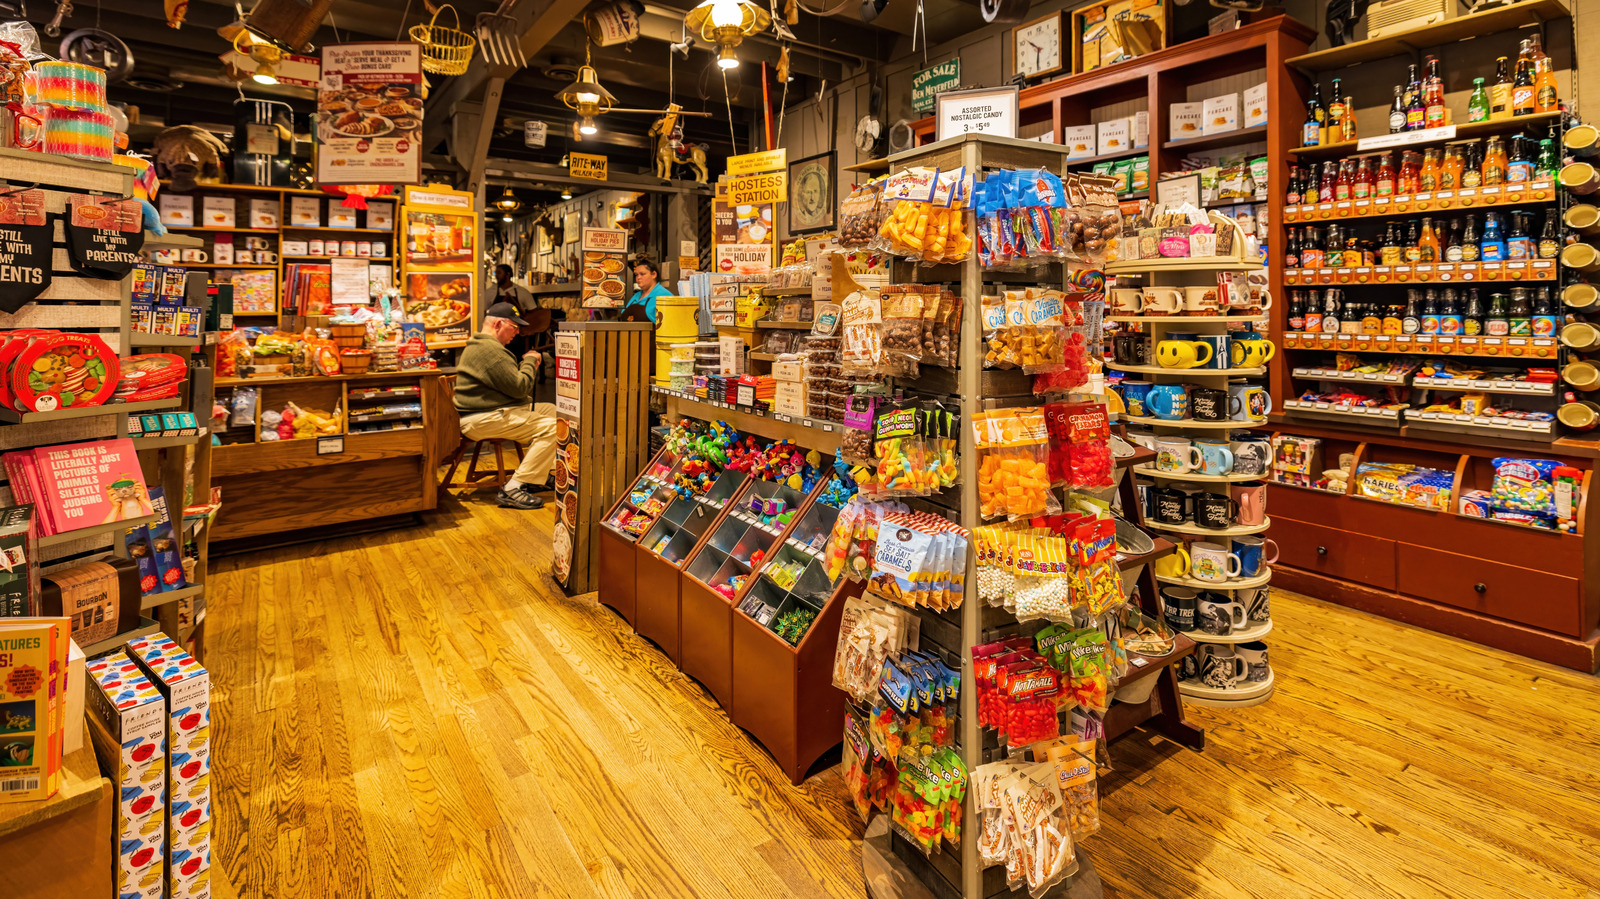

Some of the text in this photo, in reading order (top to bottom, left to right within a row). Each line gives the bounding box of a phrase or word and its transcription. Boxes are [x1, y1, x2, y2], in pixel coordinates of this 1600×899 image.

[913, 63, 957, 88] FOR SALE
[962, 105, 992, 113] ASSORTED
[951, 113, 983, 122] NOSTALGIC
[963, 124, 969, 132] 3
[571, 157, 606, 171] RITE-WAY
[572, 169, 593, 178] MILKER
[730, 175, 783, 192] HOSTESS
[735, 189, 779, 205] STATION
[722, 218, 733, 226] YOU
[93, 234, 128, 246] LIVE WITH
[105, 243, 116, 251] MY
[590, 237, 609, 245] HOLIDAY
[6, 242, 33, 255] WITH
[86, 249, 136, 264] PARENTS
[734, 252, 767, 262] HOLIDAY
[844, 302, 858, 312] COW
[1034, 297, 1060, 311] Vanilla
[1030, 304, 1063, 324] CARAMELS
[45, 335, 92, 345] DOG TREATS
[1069, 413, 1104, 424] CINNAMON
[1075, 420, 1102, 430] BEARS
[48, 446, 107, 461] THIS BOOK IS
[51, 453, 121, 470] LITERALLY JUST
[53, 463, 110, 480] PICTURES OF
[56, 475, 99, 490] ANIMALS
[58, 484, 100, 499] SILENTLY
[62, 494, 103, 509] JUDGING
[64, 507, 84, 519] YOU
[883, 544, 911, 560] SEA SALT
[1020, 550, 1033, 558] MINI
[876, 550, 912, 572] CARAMELS
[76, 591, 108, 609] BOURBON
[1166, 605, 1196, 618] TAR TREK
[1072, 643, 1106, 660] Mike Ike
[173, 680, 208, 696] FRIENDS
[1011, 676, 1053, 695] HOT TAMALE
[89, 683, 110, 722] FRIENDS
[176, 689, 205, 703] COFFEE HOUSE
[188, 692, 207, 703] SAMPLER
[125, 707, 163, 727] FRIENDS
[127, 717, 161, 732] COFFEE HOUSE
[126, 720, 161, 737] SYRUP SAMPLER
[925, 768, 940, 786] Ike
[1020, 792, 1031, 813] COW
[1023, 800, 1036, 823] TALES
